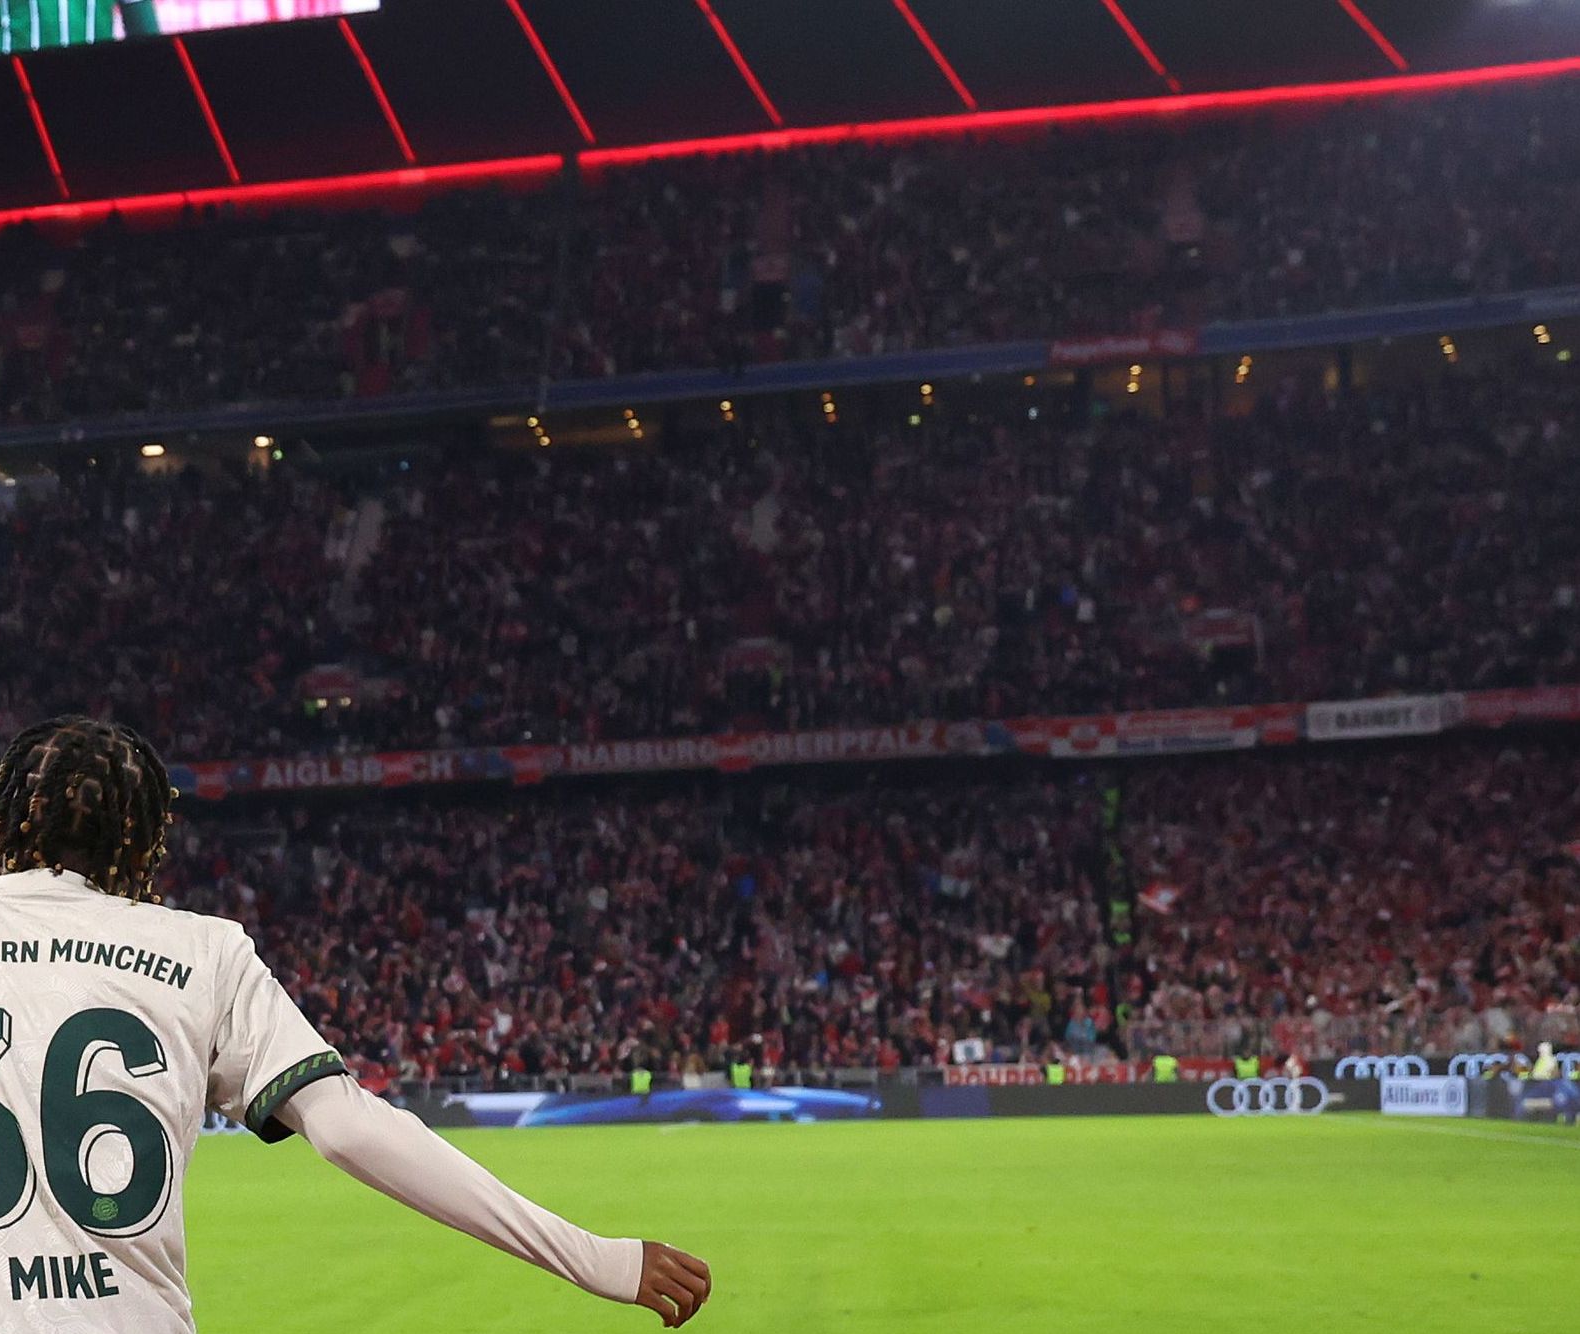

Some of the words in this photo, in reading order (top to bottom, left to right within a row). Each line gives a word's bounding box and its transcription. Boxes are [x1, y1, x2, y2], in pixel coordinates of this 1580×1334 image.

[261, 757, 454, 788] AIGLSBCH
[50, 937, 193, 990] MÜNCHEN
[1384, 1084, 1438, 1104] Allianz
[9, 1252, 120, 1301] MIKE
